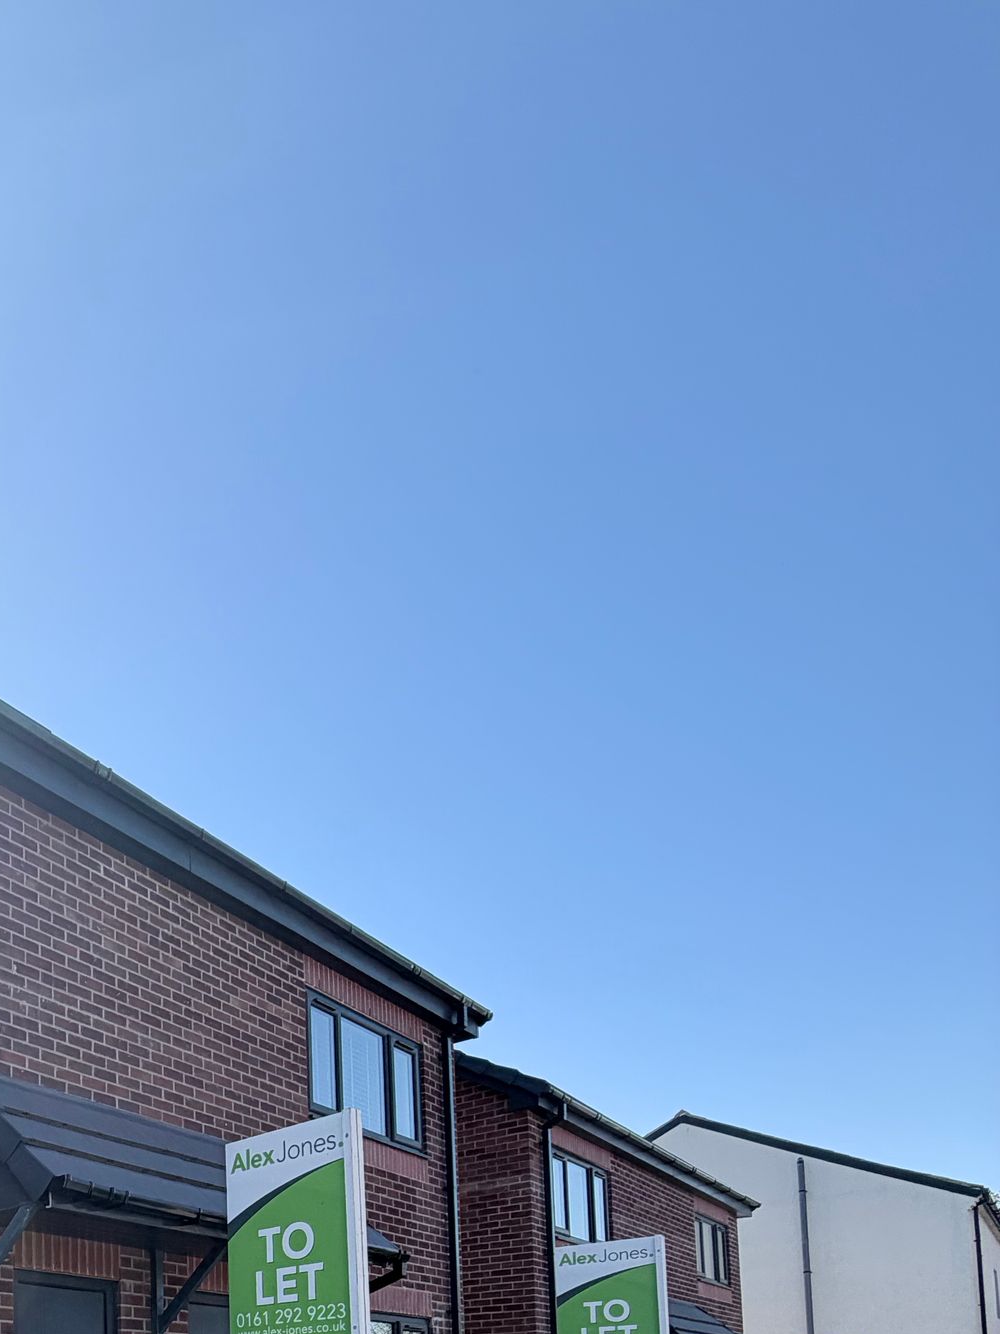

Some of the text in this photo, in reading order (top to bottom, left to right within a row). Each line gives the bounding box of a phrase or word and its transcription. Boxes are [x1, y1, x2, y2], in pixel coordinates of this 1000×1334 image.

[258, 1221, 315, 1264] TO
[255, 1261, 324, 1306] LET
[236, 1302, 347, 1328] 0161 292 9223
[583, 1299, 631, 1324] TO
